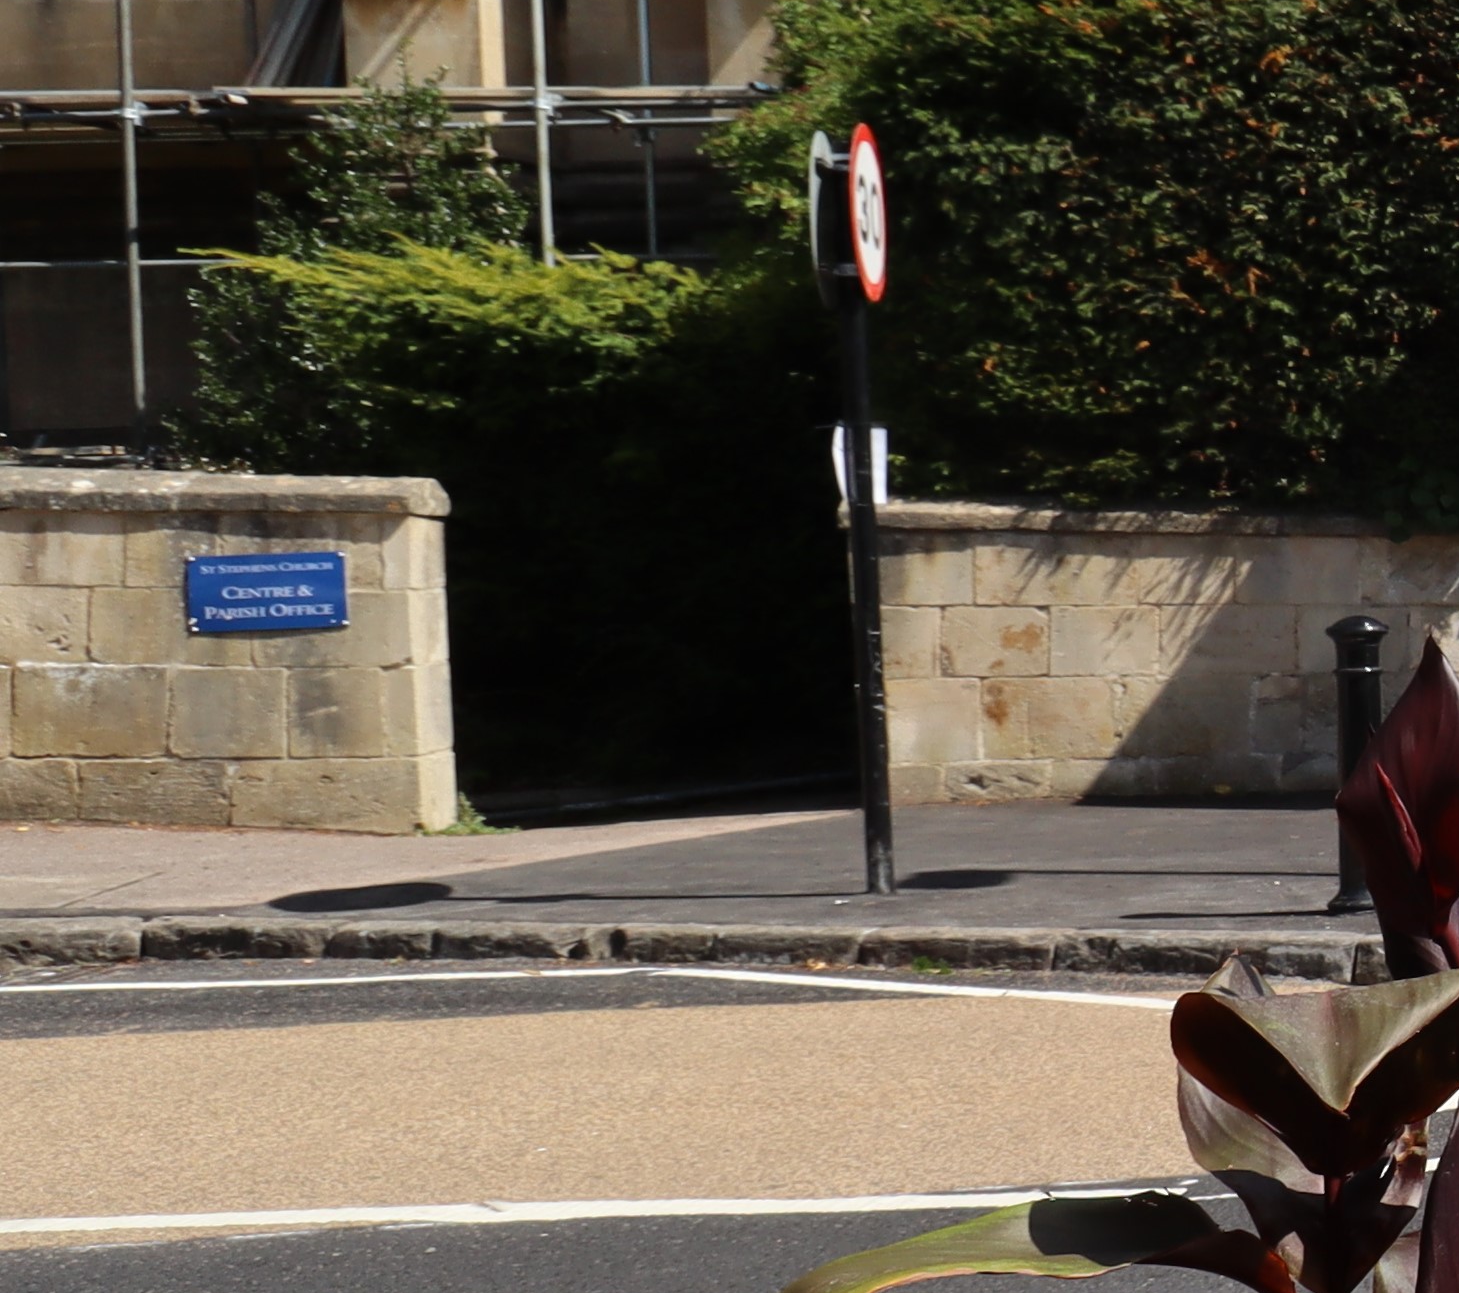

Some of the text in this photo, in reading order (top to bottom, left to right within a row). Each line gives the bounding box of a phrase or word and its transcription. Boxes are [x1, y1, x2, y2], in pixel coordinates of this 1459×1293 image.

[858, 174, 881, 249] 30
[221, 584, 314, 600] CENTRE &
[204, 603, 335, 620] PARISH OFFICE
